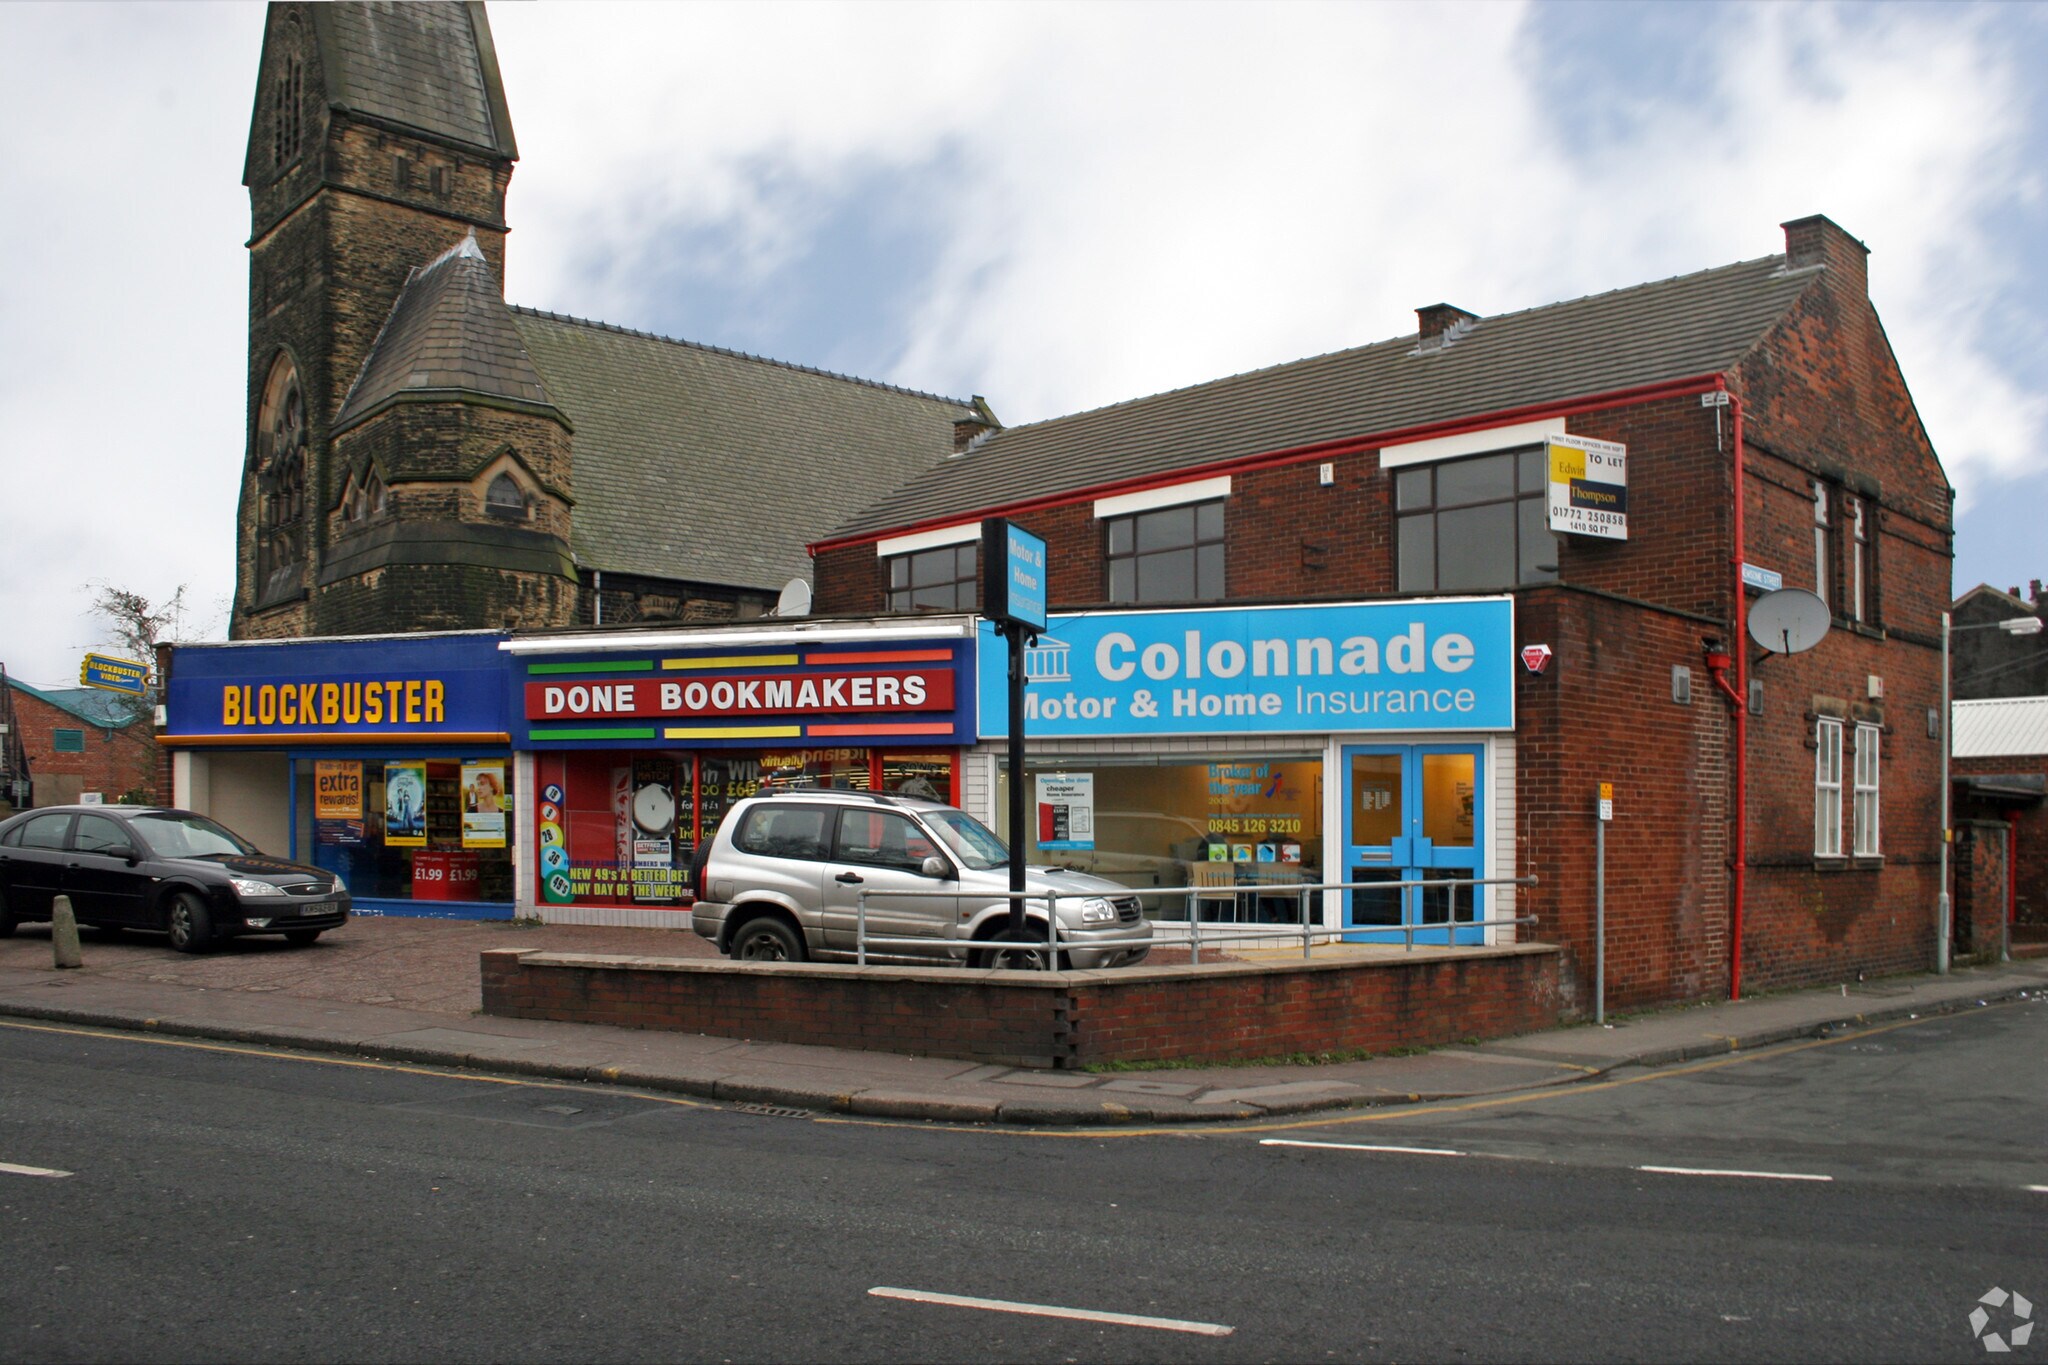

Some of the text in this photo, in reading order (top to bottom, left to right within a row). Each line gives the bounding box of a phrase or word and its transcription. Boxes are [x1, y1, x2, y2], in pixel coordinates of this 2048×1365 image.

[1559, 462, 1585, 476] Edwin
[1589, 454, 1623, 468] TO LET
[1571, 486, 1616, 505] Thompson
[1553, 506, 1624, 526] 01772 250858
[1570, 522, 1608, 534] 1410 SQ FT
[1009, 538, 1042, 568] Motor &
[1014, 565, 1037, 590] Home
[1095, 622, 1475, 682] Colonnade
[89, 661, 141, 678] BLOCKBUSTER
[101, 673, 120, 682] VIDEO
[545, 675, 926, 713] DONE BOOKMAKERS
[1129, 689, 1158, 718] &
[1173, 688, 1283, 717] Home
[1297, 685, 1476, 714] Insurance
[223, 680, 445, 726] BLOCKBUSTER
[760, 754, 804, 769] virtually
[1208, 762, 1270, 778] Broker of
[320, 772, 358, 792] extra
[1209, 782, 1262, 798] the year
[320, 792, 359, 806] rewards!
[549, 788, 558, 800] 19
[1208, 819, 1301, 832] 0845 126 3210
[542, 829, 554, 843] 28
[548, 850, 560, 866] 36
[415, 868, 443, 880] £1.99
[450, 869, 478, 882] £1.99
[570, 868, 689, 882] NEW 49's A BETTER BET
[571, 882, 682, 898] ANY DAY OF THE WEEK
